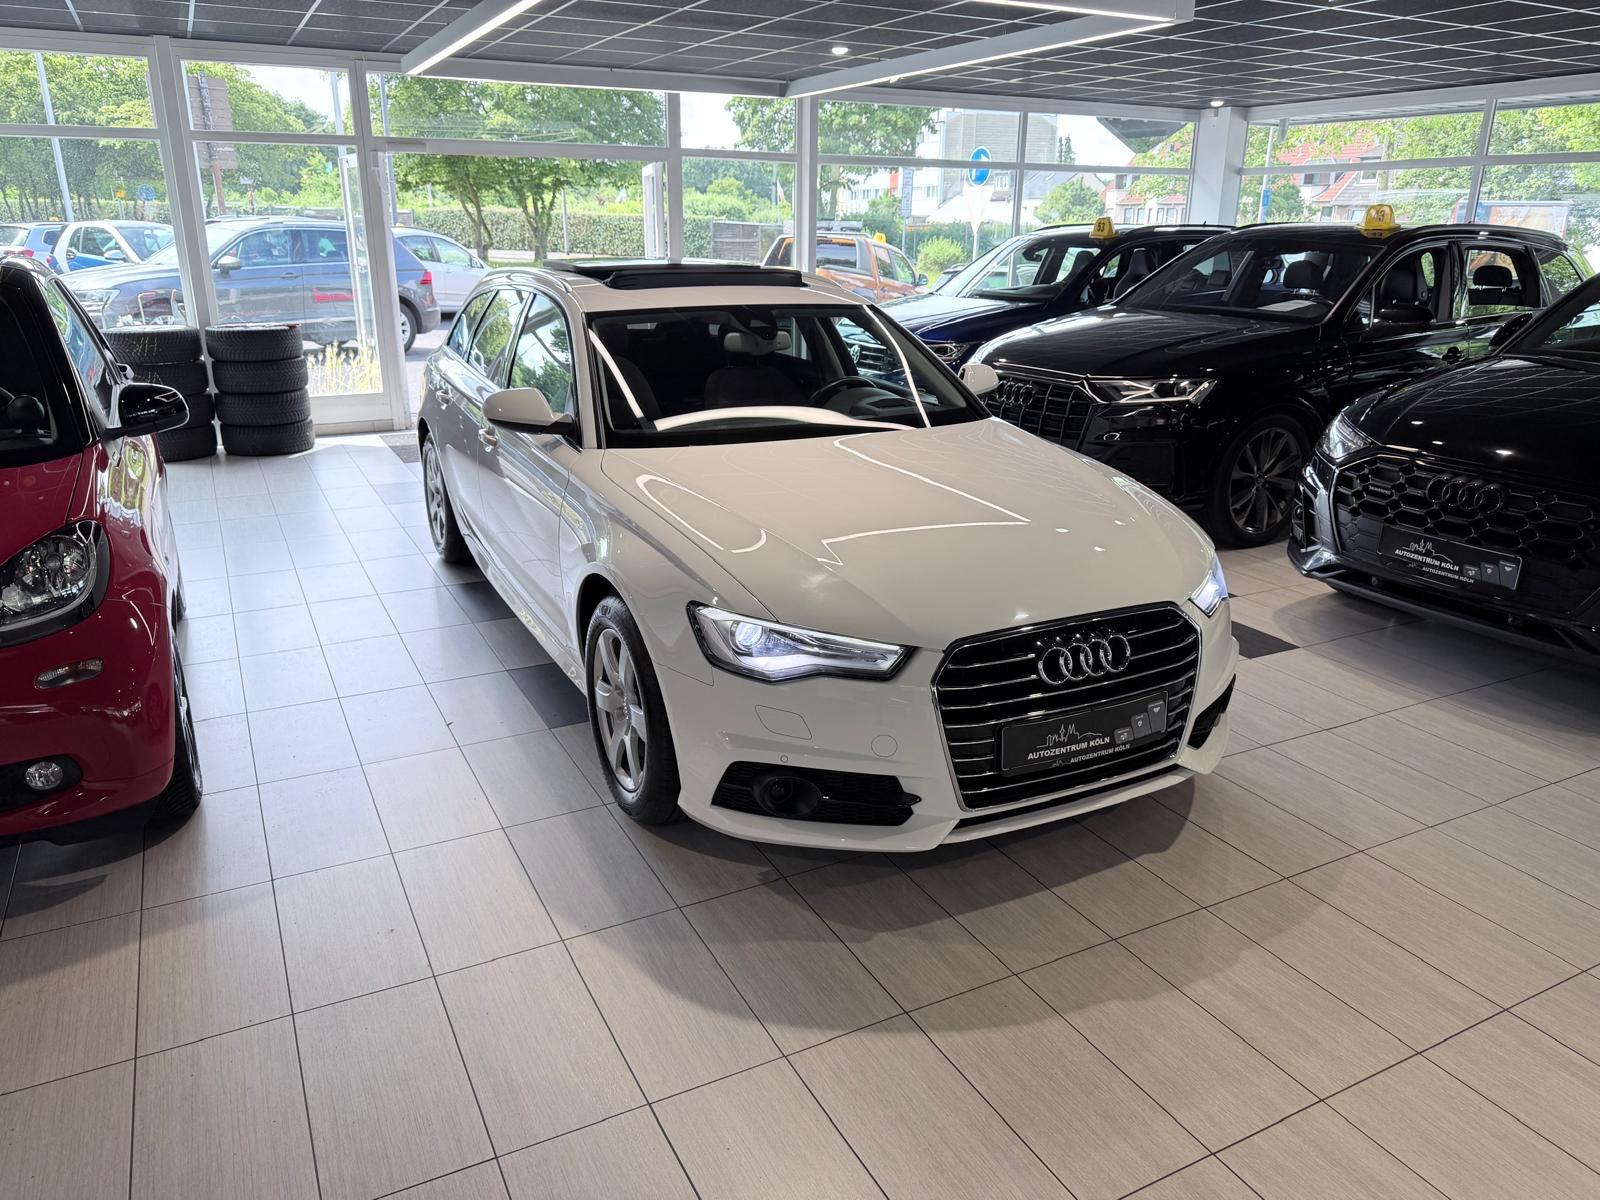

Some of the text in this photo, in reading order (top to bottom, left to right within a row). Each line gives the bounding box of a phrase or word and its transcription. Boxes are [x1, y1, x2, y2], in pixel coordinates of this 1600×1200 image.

[1394, 549, 1460, 572] AUTOZENTRUM KÖLN
[1421, 566, 1459, 580] AUTOZENTRUM
[1459, 576, 1475, 584] KÖLN
[1027, 736, 1110, 760] AUTOZENTRUM KÖLN
[1070, 743, 1131, 763] AUTOZENTRUM KÖLN
